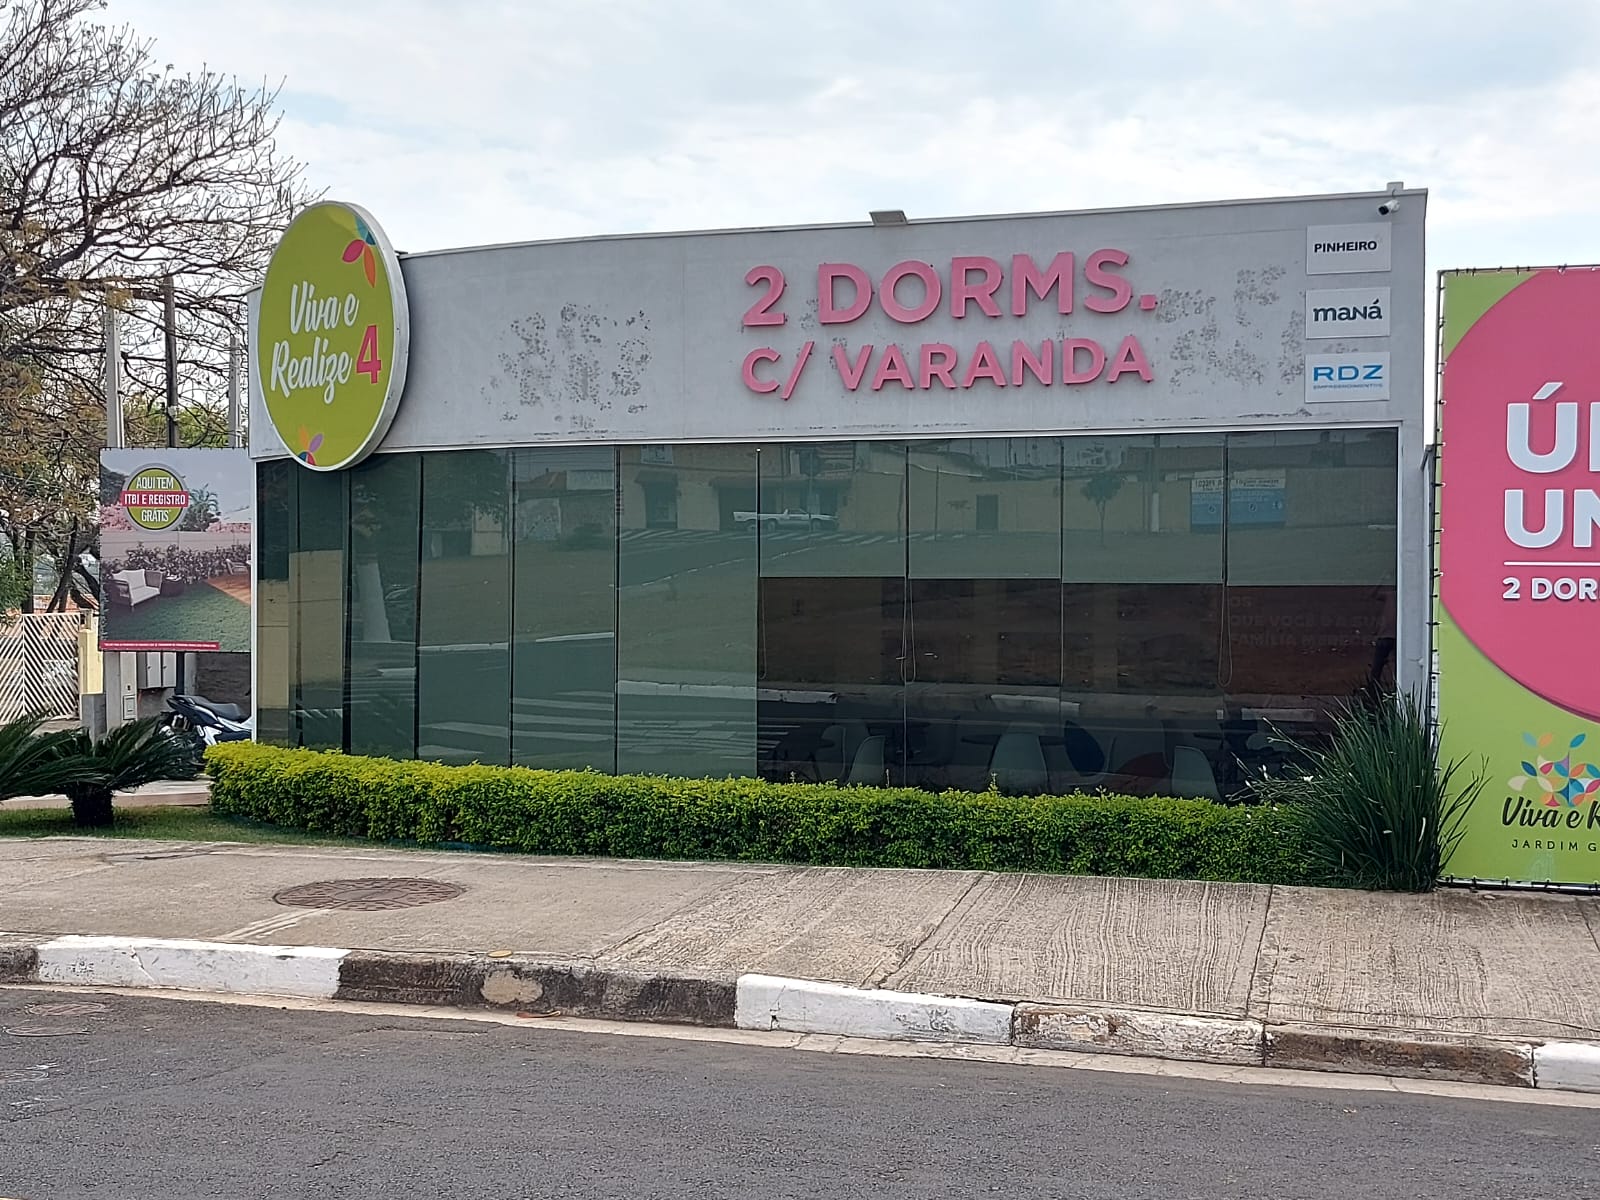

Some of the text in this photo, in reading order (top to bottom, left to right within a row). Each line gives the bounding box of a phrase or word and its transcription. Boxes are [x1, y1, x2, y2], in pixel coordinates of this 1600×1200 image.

[1314, 240, 1378, 253] PINHEIRO
[742, 248, 1158, 327] 2 DORMS.
[290, 280, 360, 335] Viva e
[1313, 298, 1383, 322] maná
[270, 324, 382, 404] Realize 4
[741, 334, 1155, 401] C/ VARANDA
[1313, 364, 1384, 382] RDZ
[1506, 382, 1600, 473] Ú
[136, 476, 174, 489] AQUI TEM
[142, 494, 148, 505] E
[148, 494, 186, 505] REGISTRO
[1502, 577, 1600, 600] 2 DOR
[1502, 796, 1563, 828] Viva
[1566, 810, 1584, 829] e
[1511, 839, 1578, 851] JARDIM
